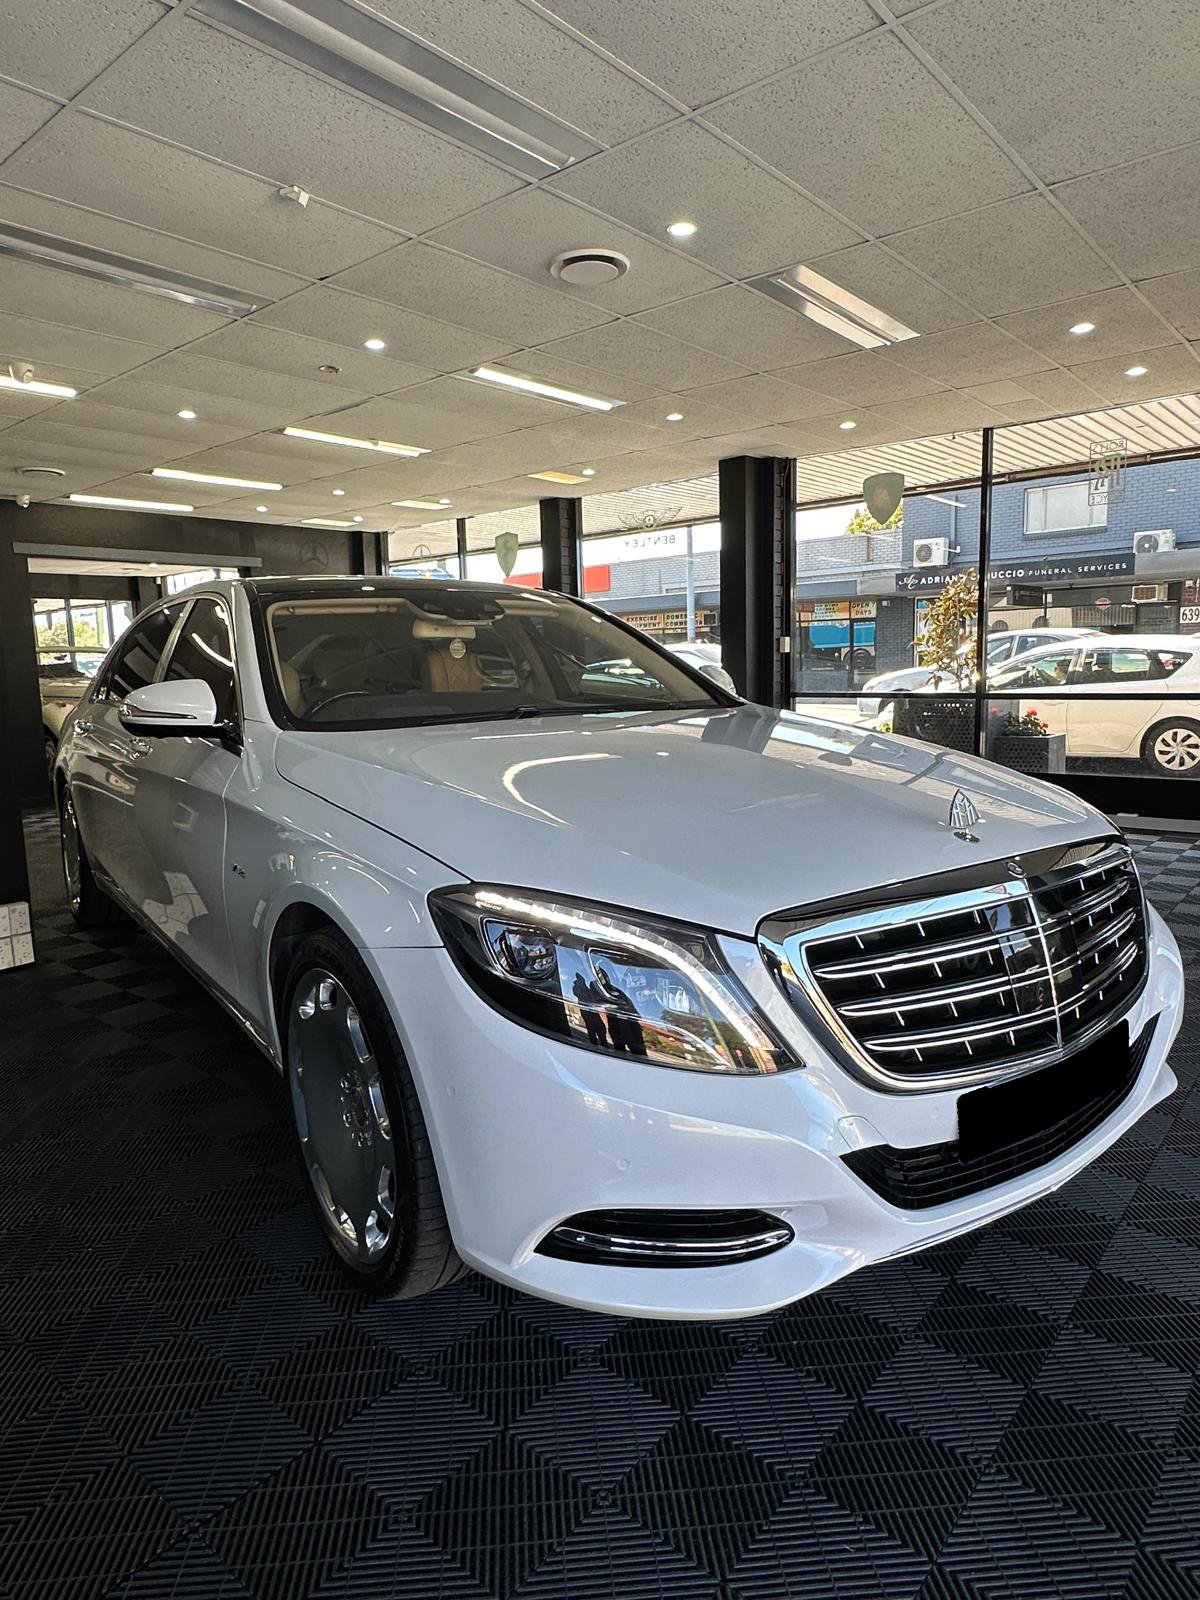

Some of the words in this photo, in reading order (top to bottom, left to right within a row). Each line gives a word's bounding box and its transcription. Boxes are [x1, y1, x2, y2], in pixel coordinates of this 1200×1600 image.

[970, 570, 1024, 580] CUCCIO
[1028, 567, 1072, 576] FUNERAL
[1077, 562, 1127, 573] SERVICES
[1182, 608, 1199, 621] 639
